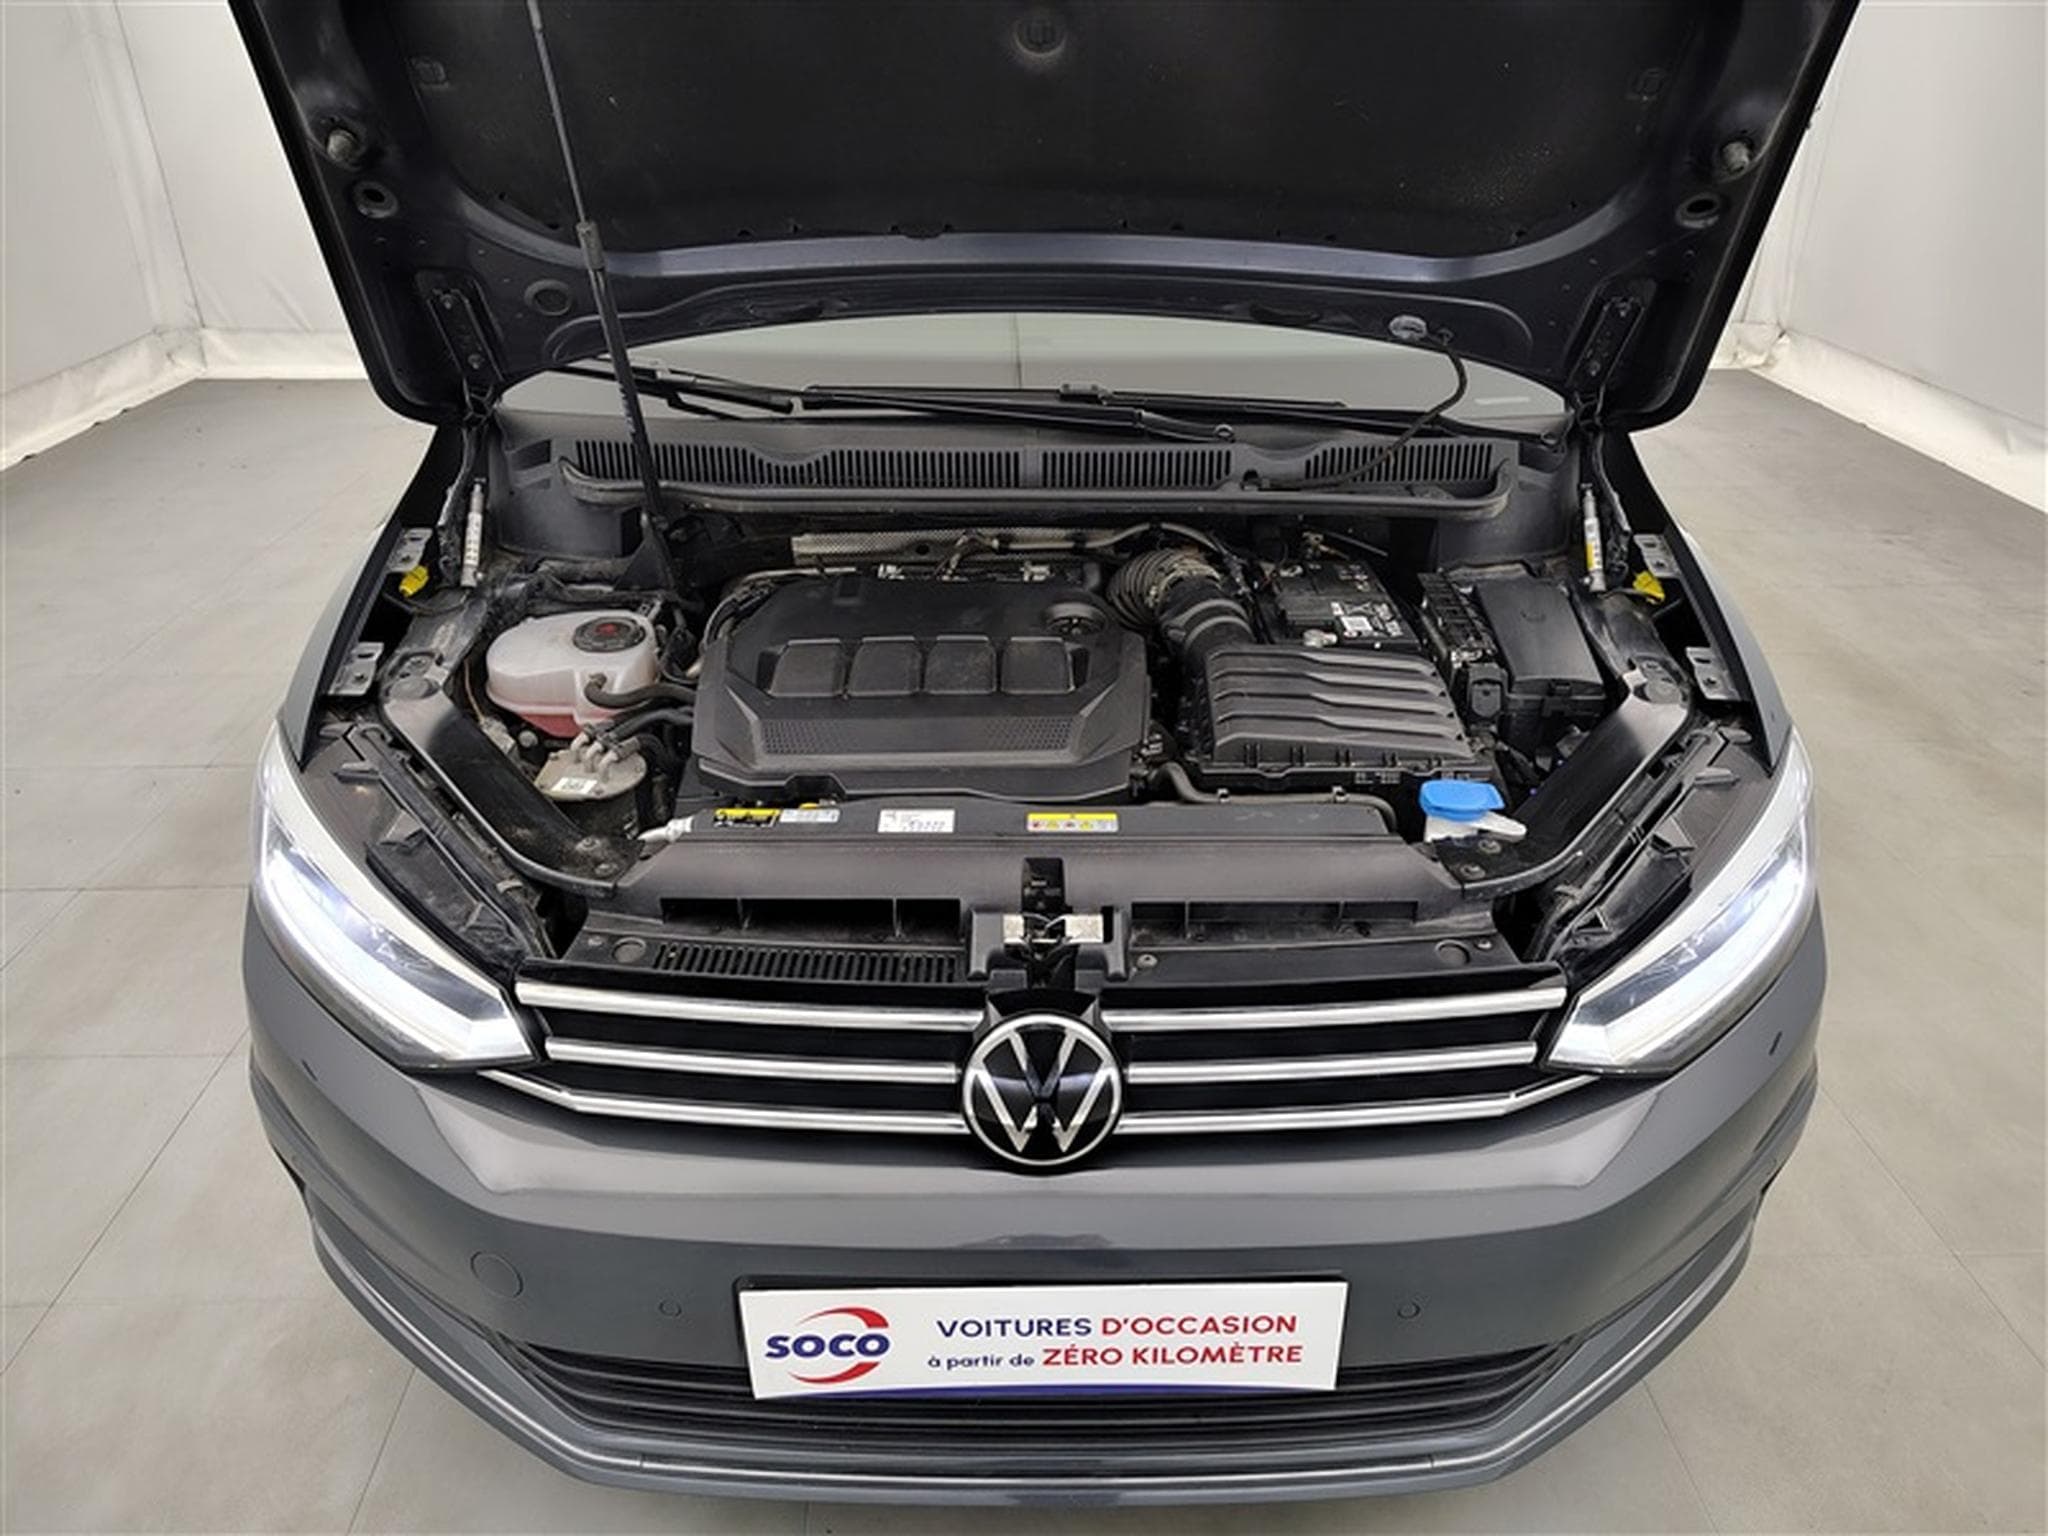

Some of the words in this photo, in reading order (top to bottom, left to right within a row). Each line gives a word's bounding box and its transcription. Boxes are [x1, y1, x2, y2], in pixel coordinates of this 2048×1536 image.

[936, 1317, 1092, 1338] VOITURES
[1101, 1314, 1297, 1336] D'OCCASION
[764, 1332, 891, 1359] SOCO
[927, 1353, 941, 1368] à
[946, 1353, 1003, 1372] partir
[1008, 1352, 1035, 1367] de
[1042, 1342, 1124, 1366] ZÉRO
[1132, 1341, 1303, 1365] KILOMÈTRE
